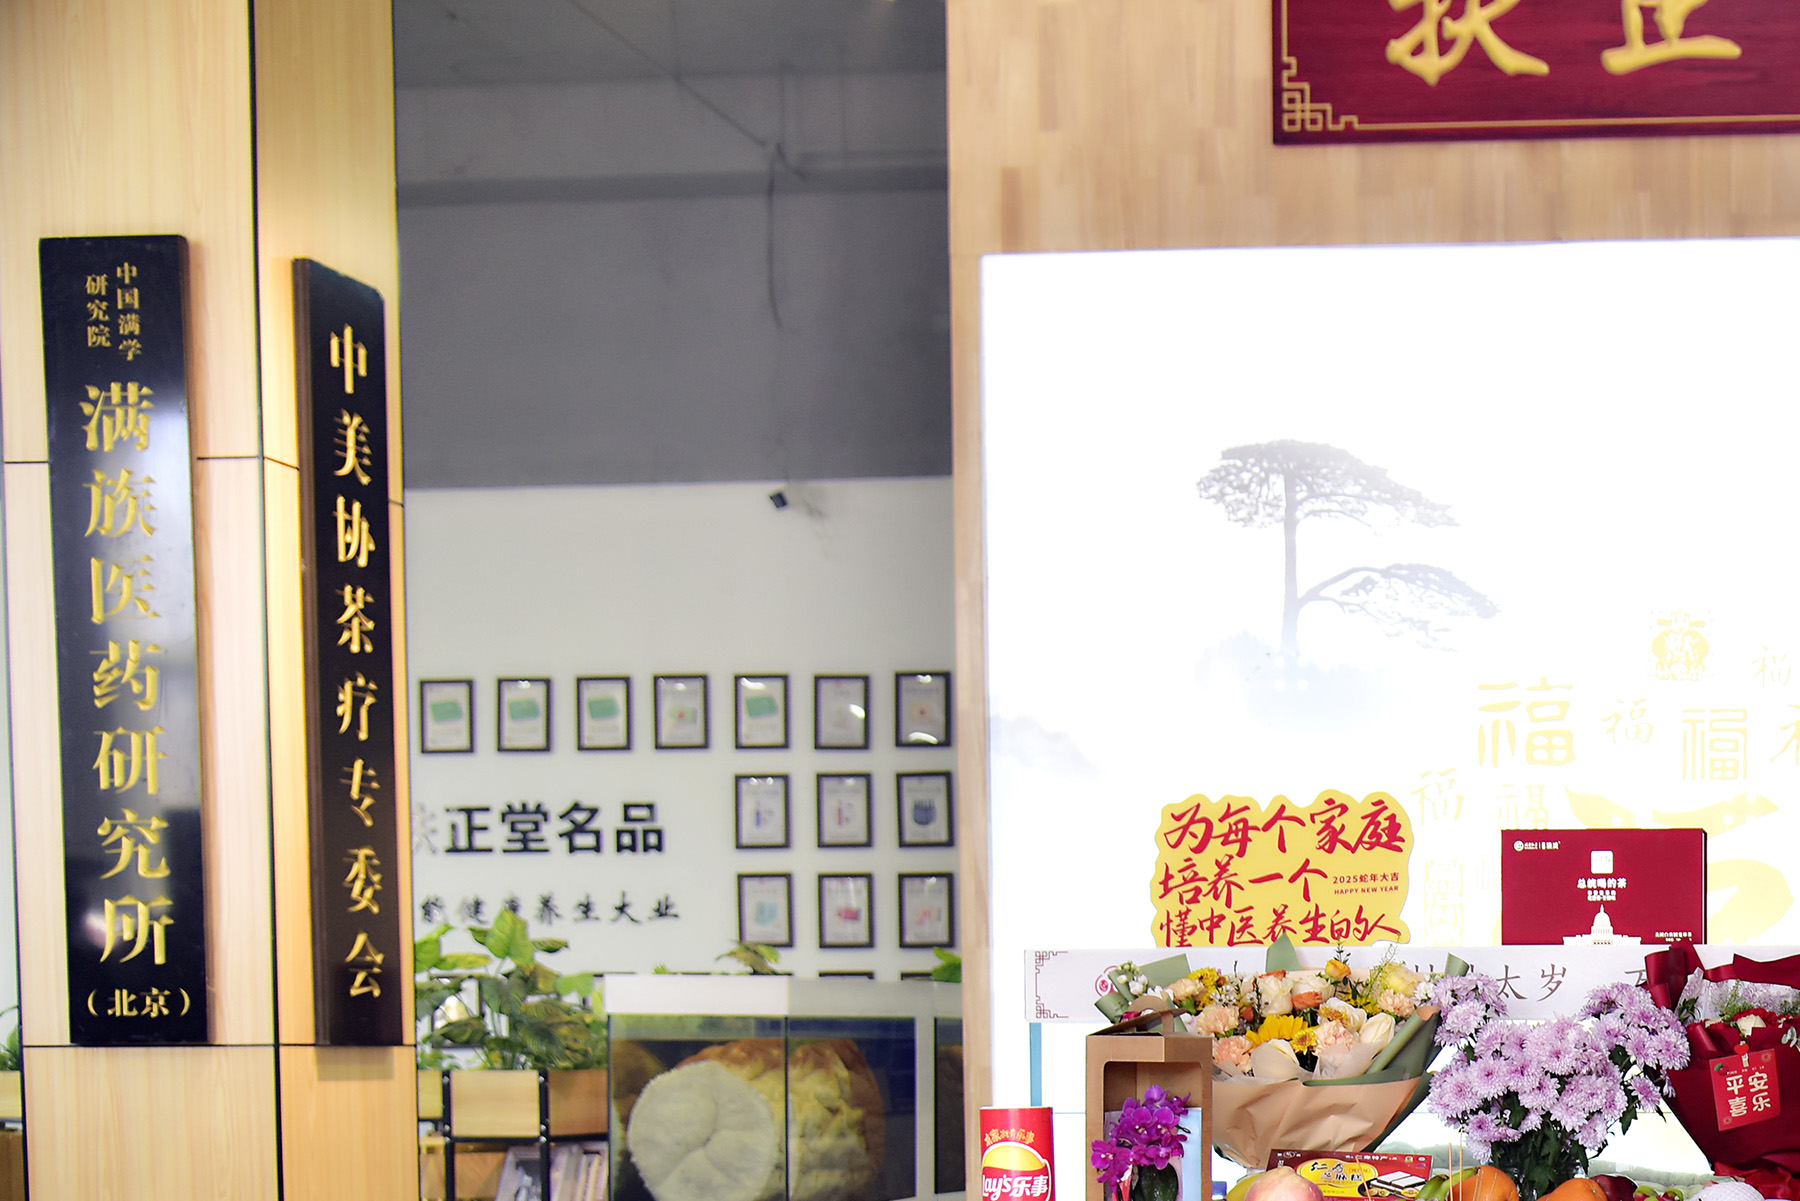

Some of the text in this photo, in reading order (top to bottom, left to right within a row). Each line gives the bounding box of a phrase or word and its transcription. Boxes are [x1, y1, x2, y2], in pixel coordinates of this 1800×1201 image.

[85, 273, 112, 348] 研究院
[116, 261, 143, 362] 中国满学
[79, 381, 175, 966] 满族医药研究所
[329, 322, 386, 999] 中美协茶疗专委会
[1477, 675, 1578, 768] 福
[1600, 697, 1656, 745] 福
[1681, 706, 1749, 782] 福
[1163, 797, 1406, 858] 为每个家庭
[1158, 853, 1329, 908] 培养一个
[1332, 871, 1400, 884] 2025蛇年大吉
[1334, 885, 1400, 895] HAPPY NEW YEAR
[1160, 902, 1402, 948] 懂中医养生的人
[1726, 1071, 1769, 1095] 平安
[1728, 1091, 1772, 1118] 喜乐
